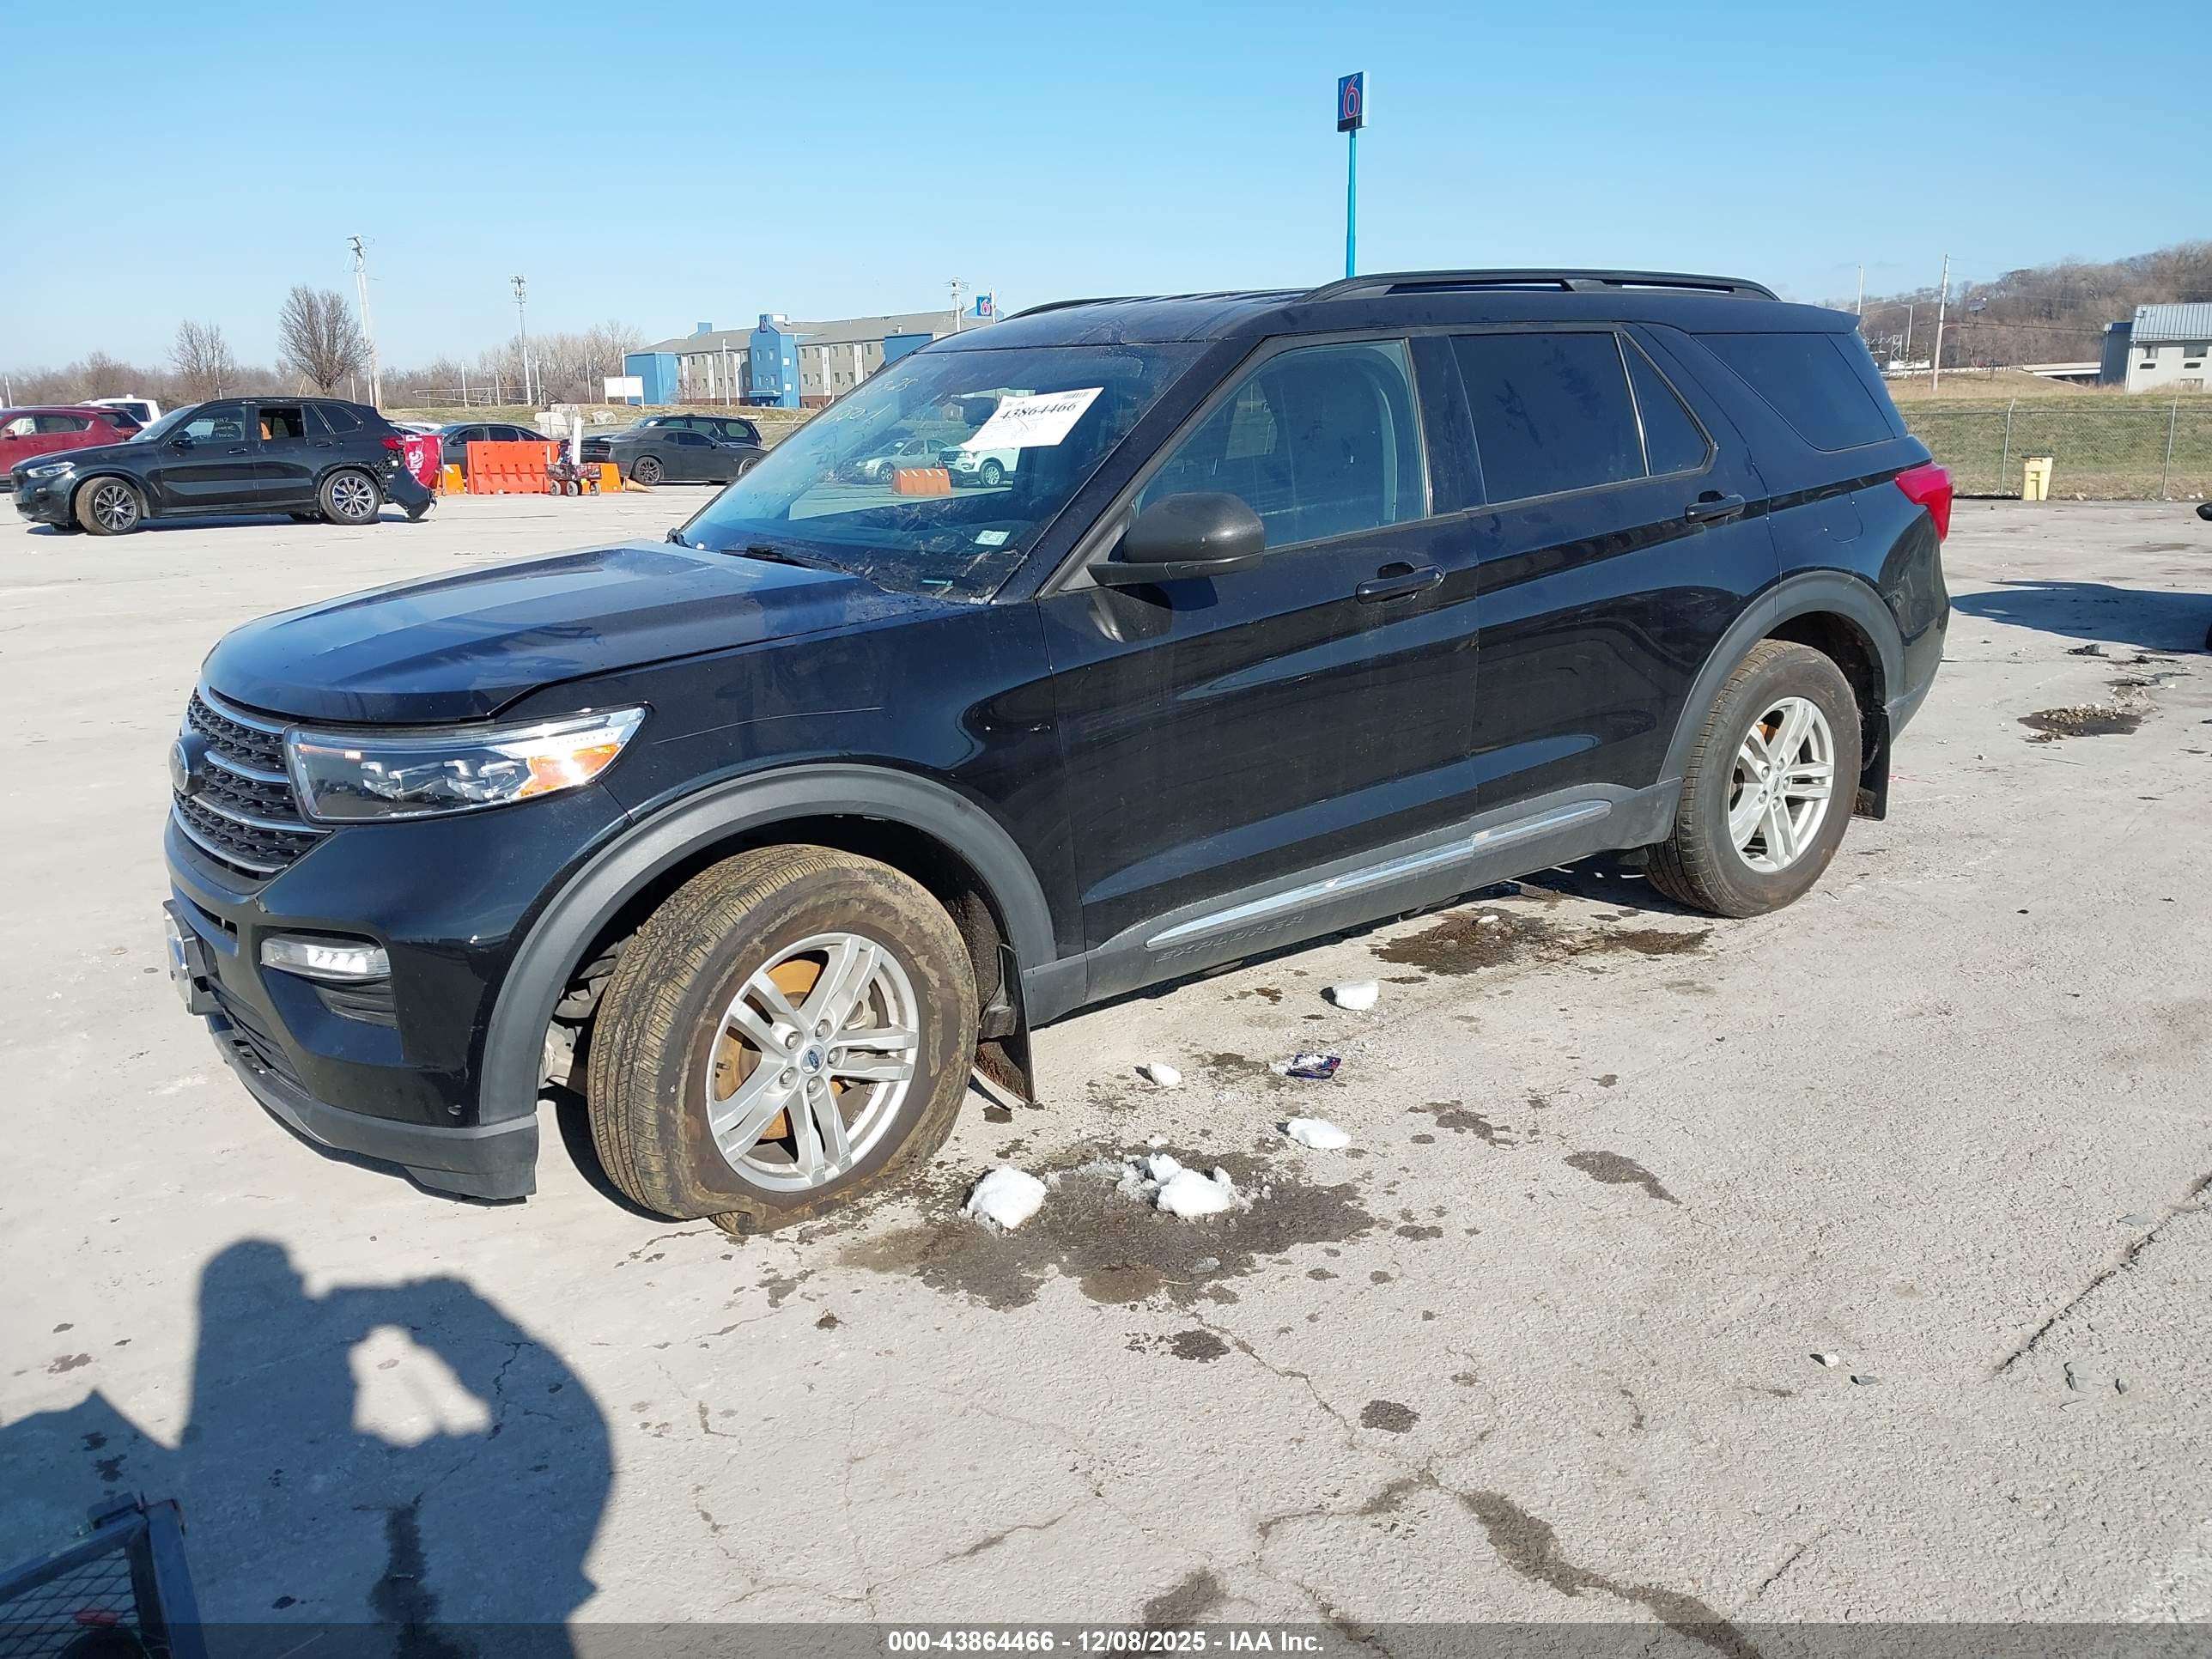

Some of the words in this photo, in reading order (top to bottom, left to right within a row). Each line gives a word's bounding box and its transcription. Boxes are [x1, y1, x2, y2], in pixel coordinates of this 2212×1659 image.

[1343, 75, 1360, 118] 6
[981, 298, 991, 316] 6
[1000, 400, 1081, 420] 43864466
[1155, 915, 1305, 963] EXPLORER
